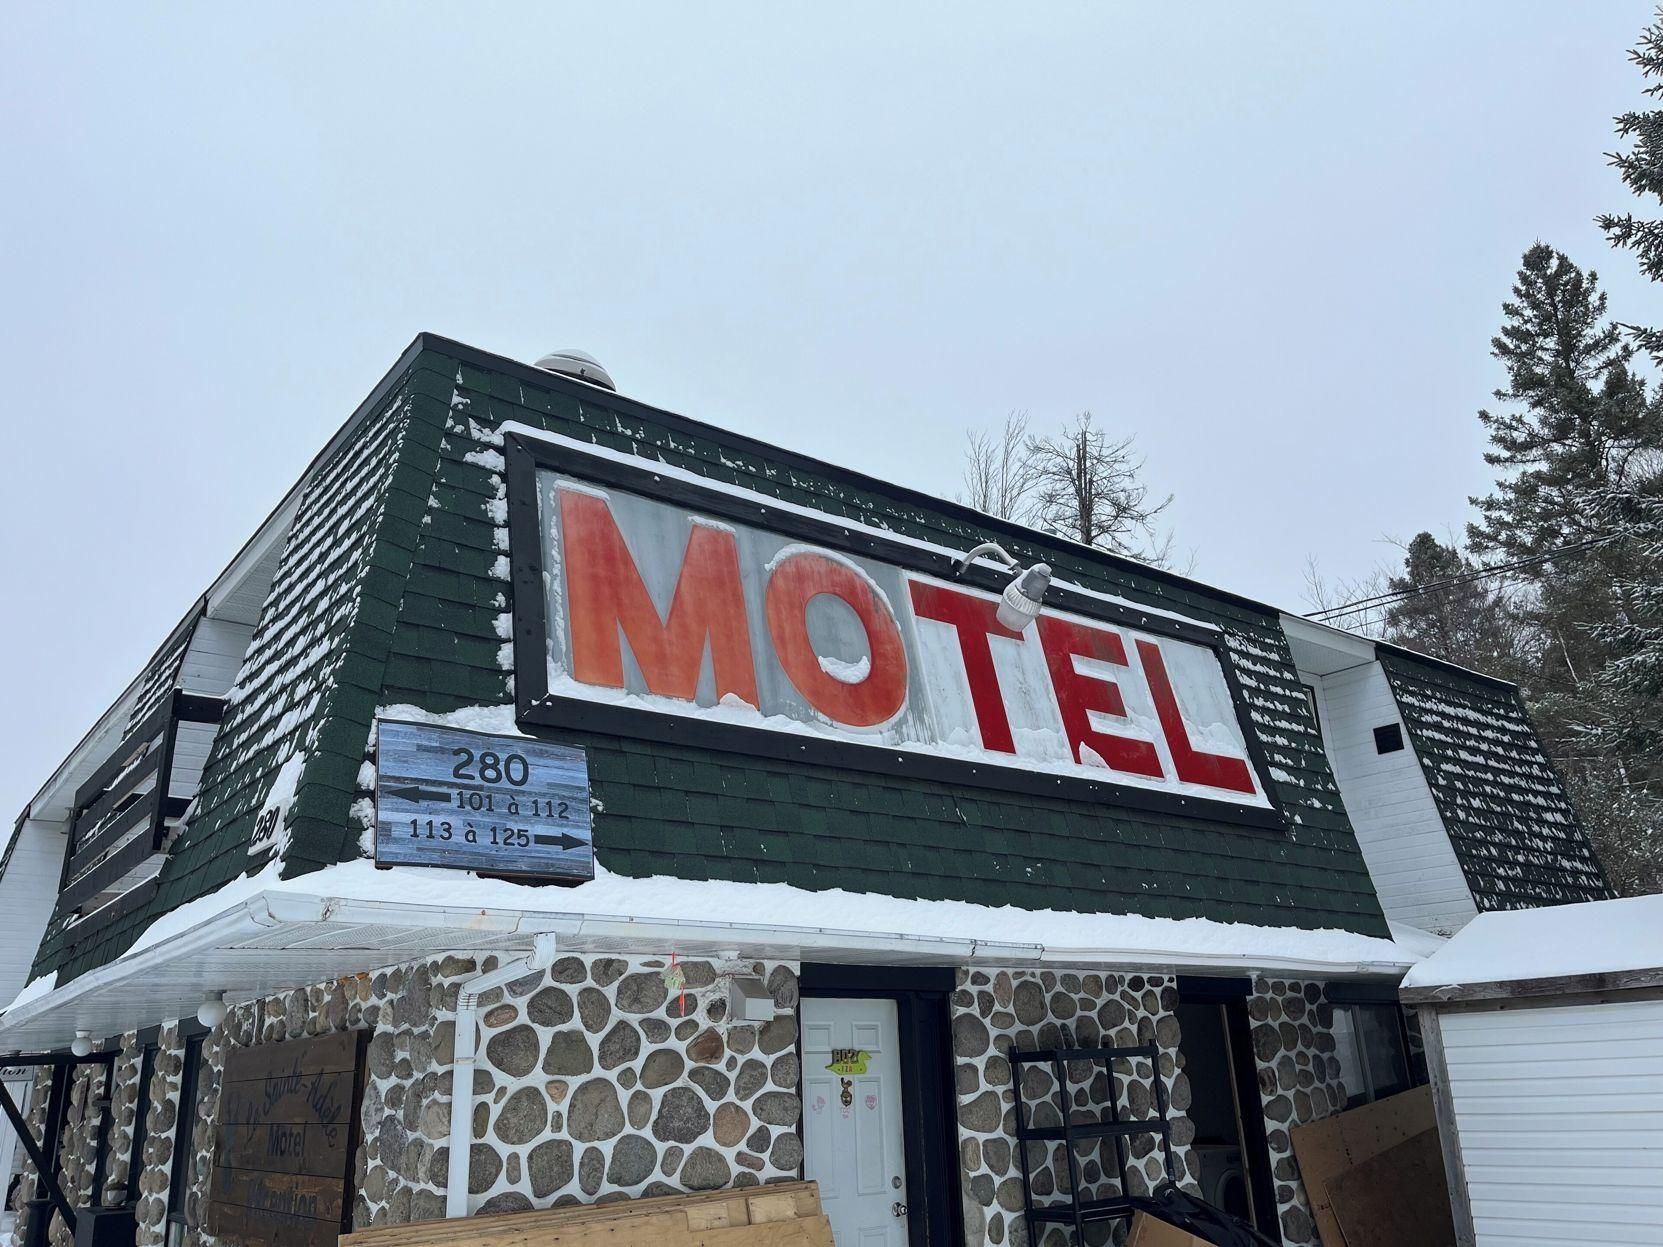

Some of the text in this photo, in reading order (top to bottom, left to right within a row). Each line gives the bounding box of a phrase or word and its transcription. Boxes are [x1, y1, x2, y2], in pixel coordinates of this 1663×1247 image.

[558, 486, 1258, 795] MOTEL
[452, 747, 530, 787] 280
[456, 790, 570, 819] 101 à 112
[250, 806, 281, 848] 280
[409, 818, 530, 848] 113 à 125
[267, 1121, 308, 1158] Motel
